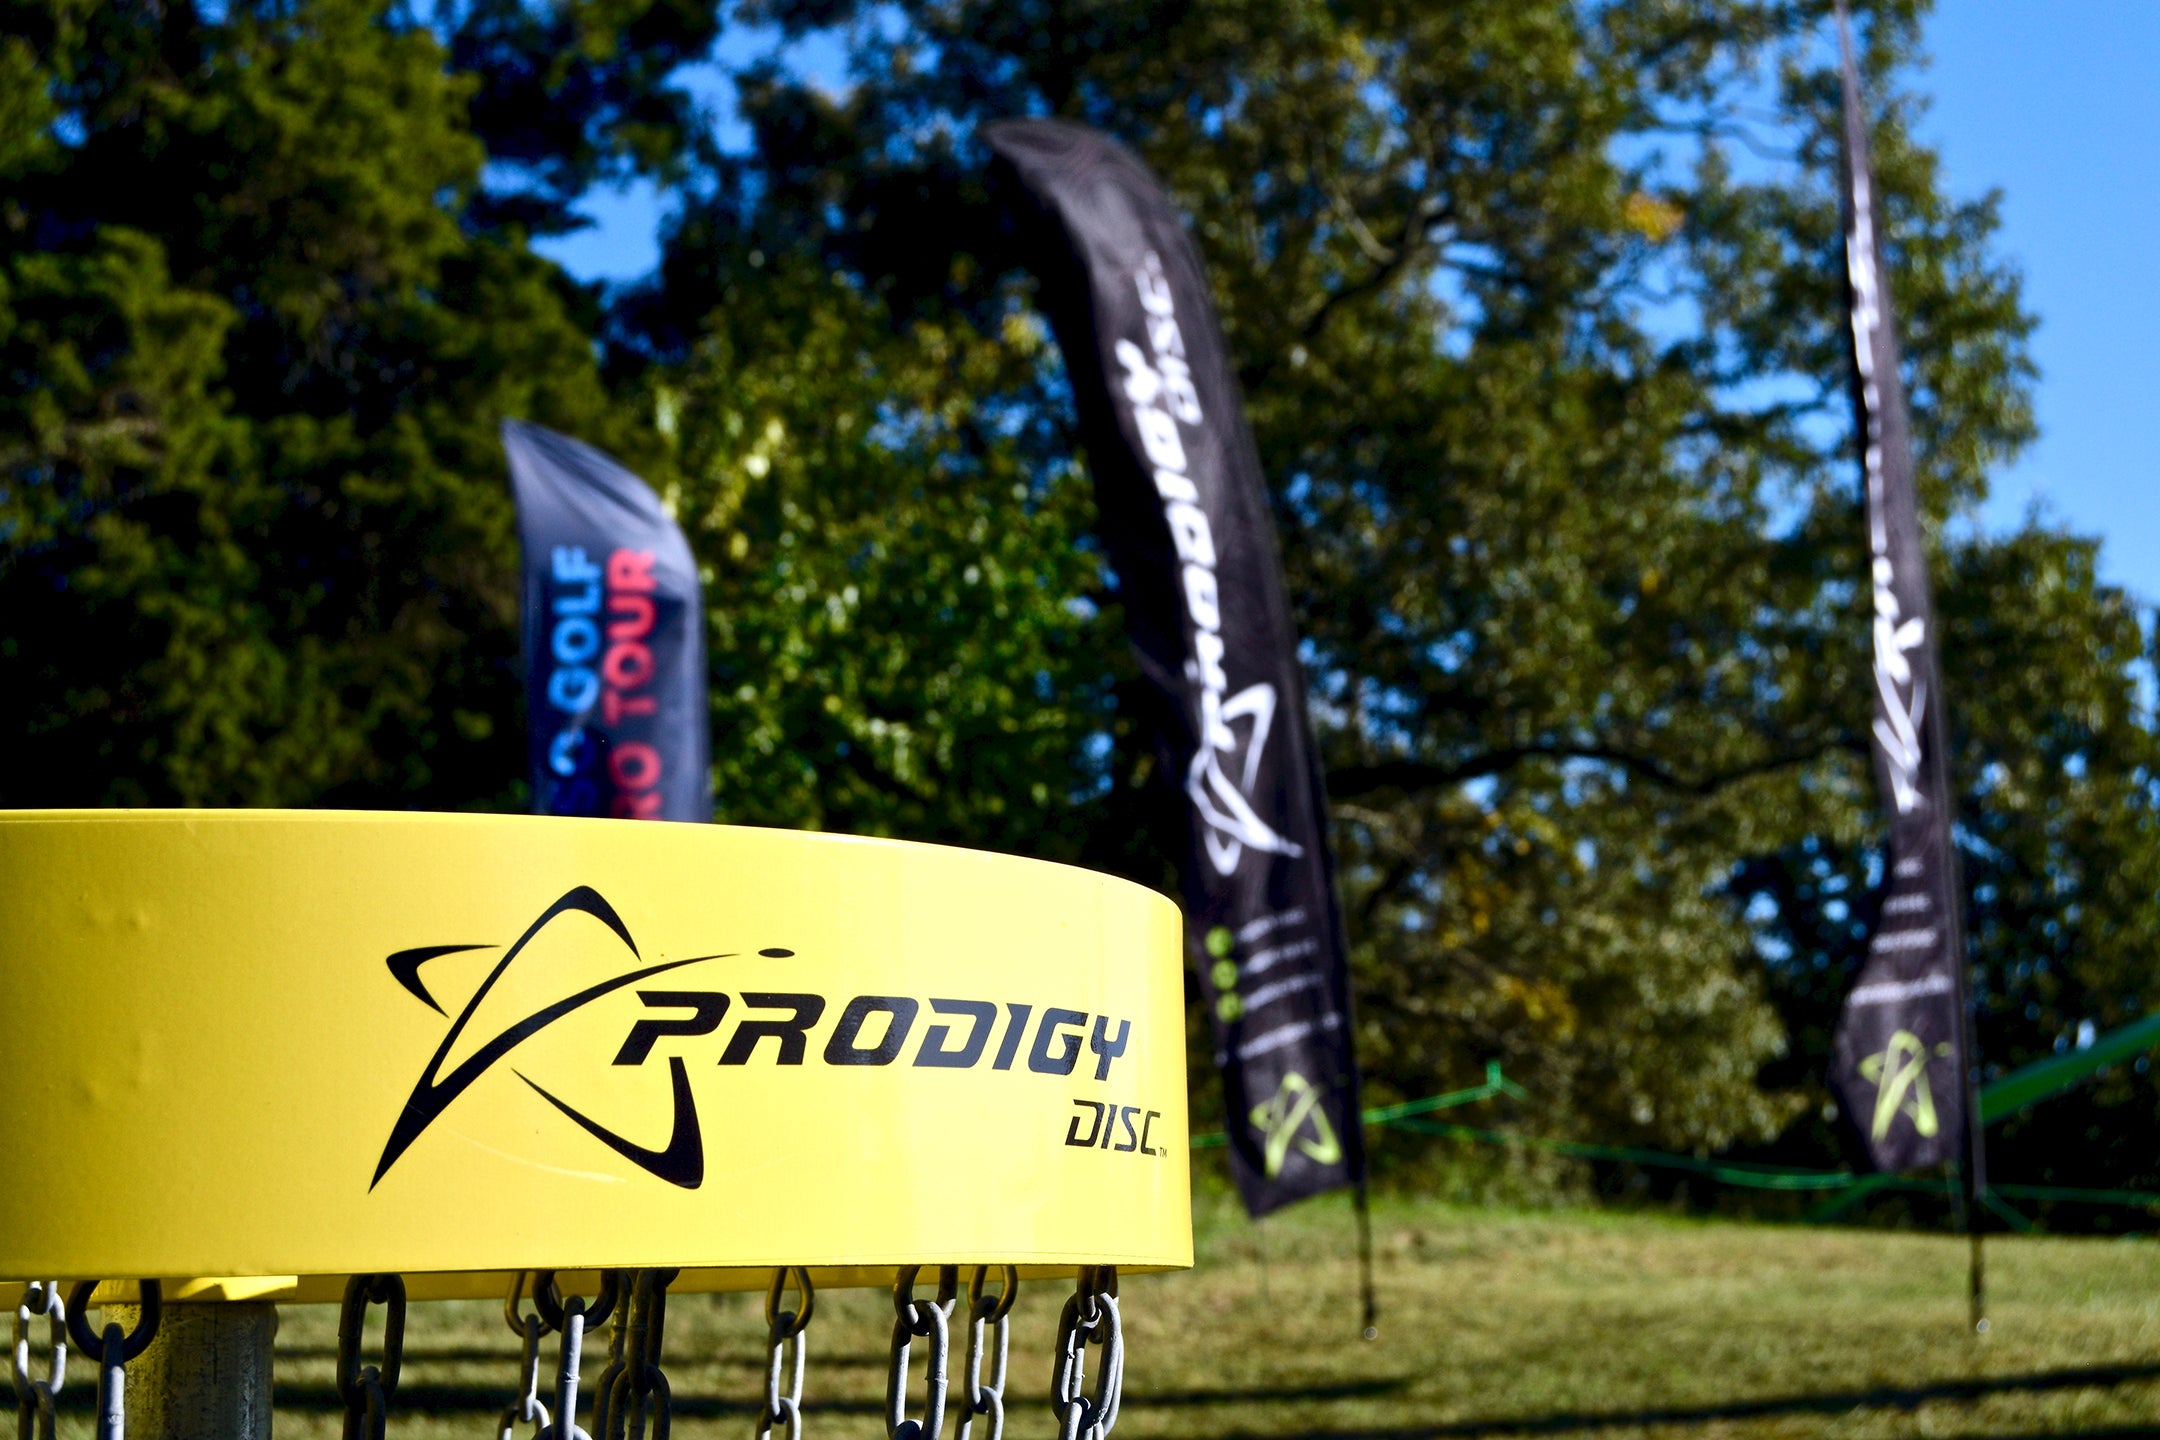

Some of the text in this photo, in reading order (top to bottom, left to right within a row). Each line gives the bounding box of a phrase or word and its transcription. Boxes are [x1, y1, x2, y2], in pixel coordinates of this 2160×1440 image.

[549, 545, 600, 713] GOLF
[604, 548, 657, 726] TOUR
[611, 991, 1130, 1080] PRODIGY
[1065, 1099, 1160, 1156] DISC
